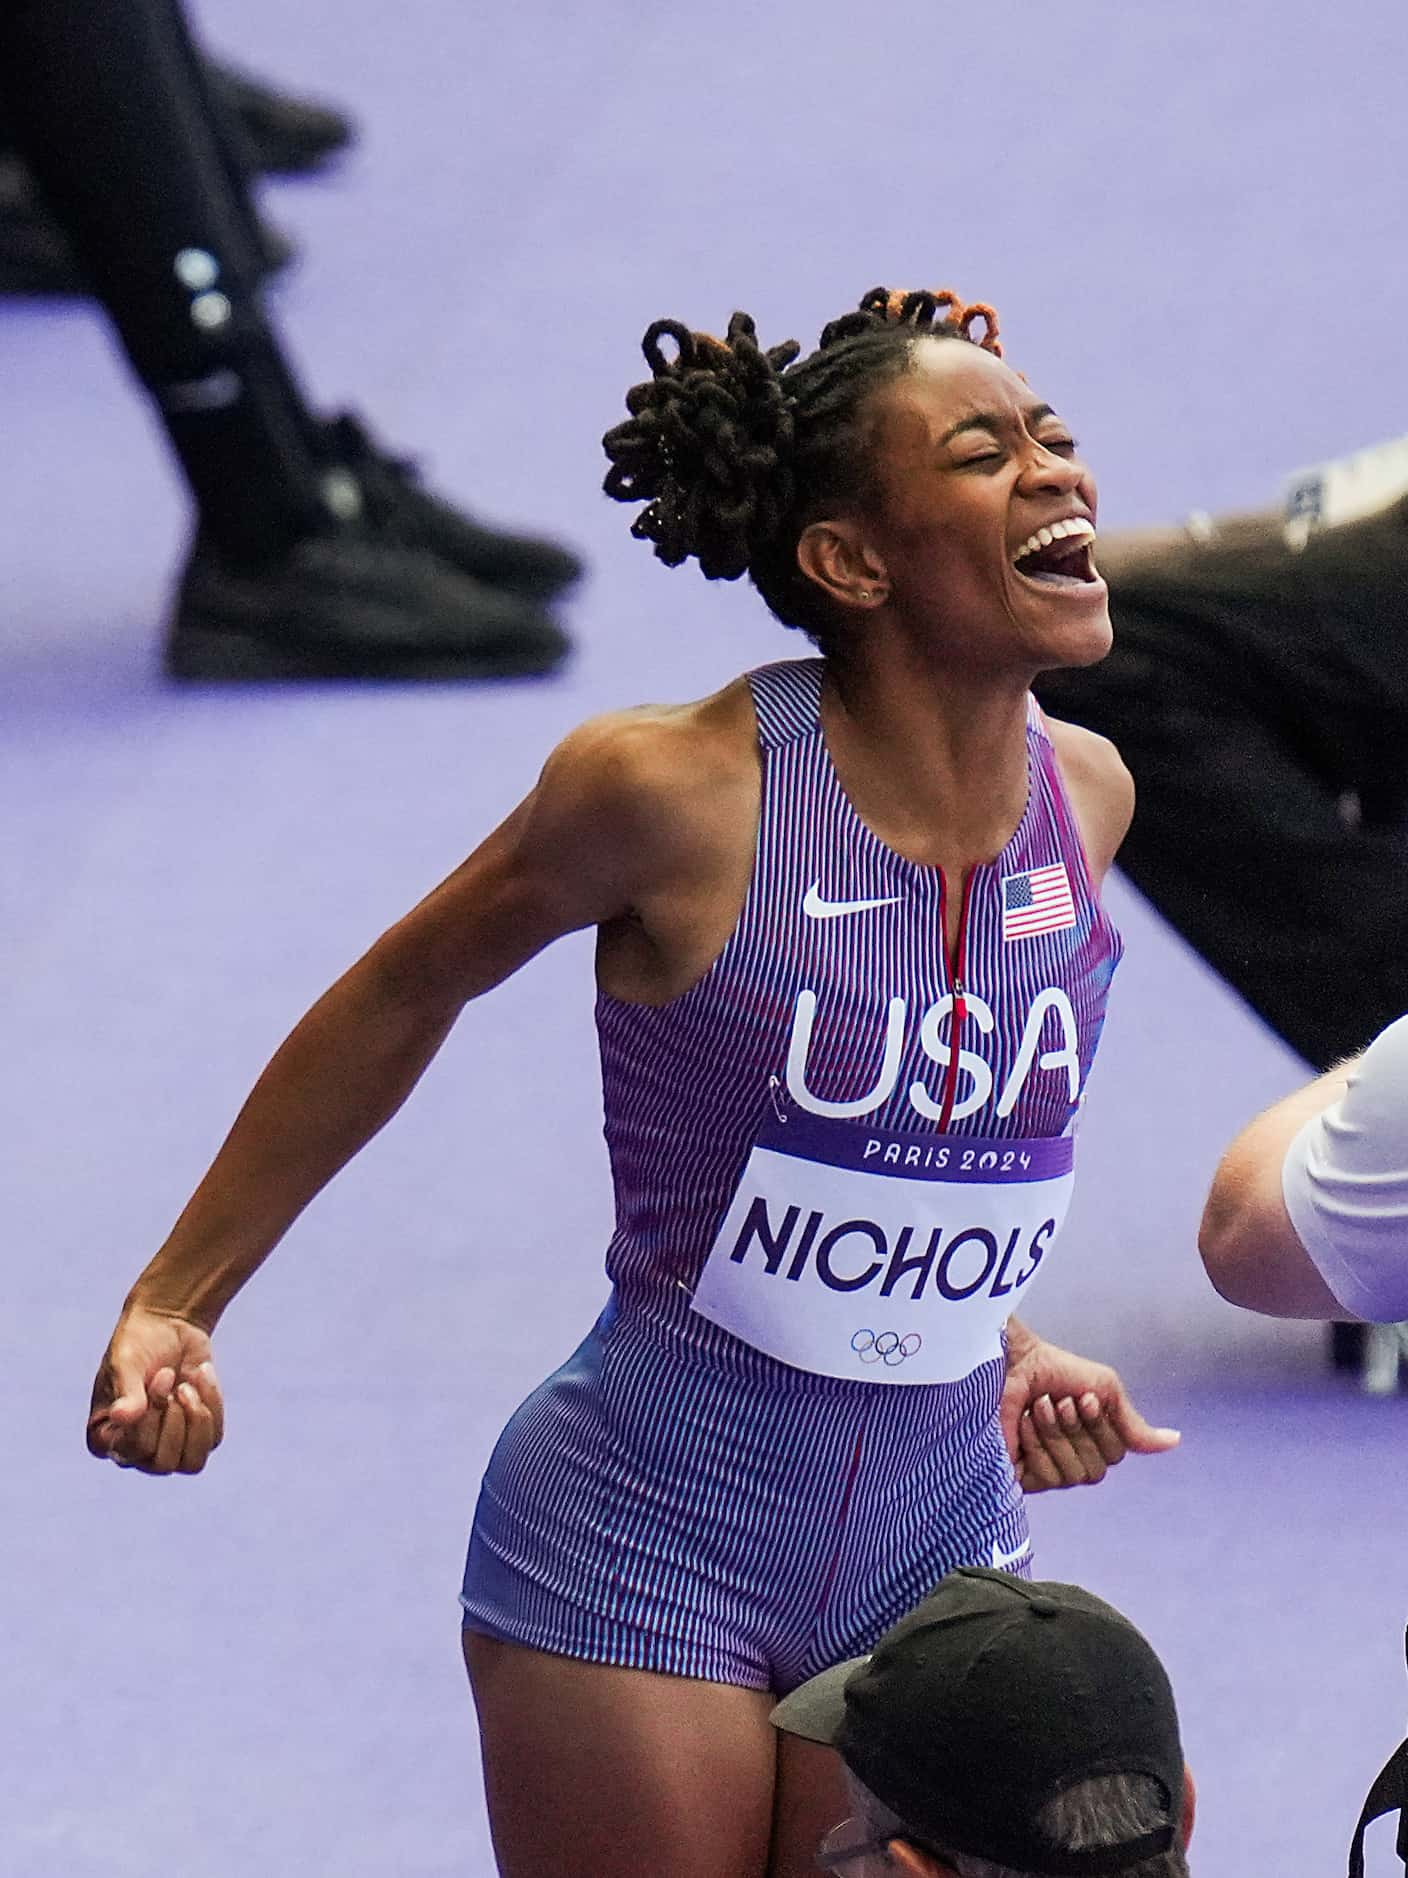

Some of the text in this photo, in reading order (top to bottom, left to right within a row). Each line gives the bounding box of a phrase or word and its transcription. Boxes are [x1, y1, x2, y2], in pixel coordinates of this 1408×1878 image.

[786, 986, 1080, 1121] USA
[863, 1139, 1033, 1172] PARIS 2024
[729, 1196, 1055, 1301] NICHOLS
